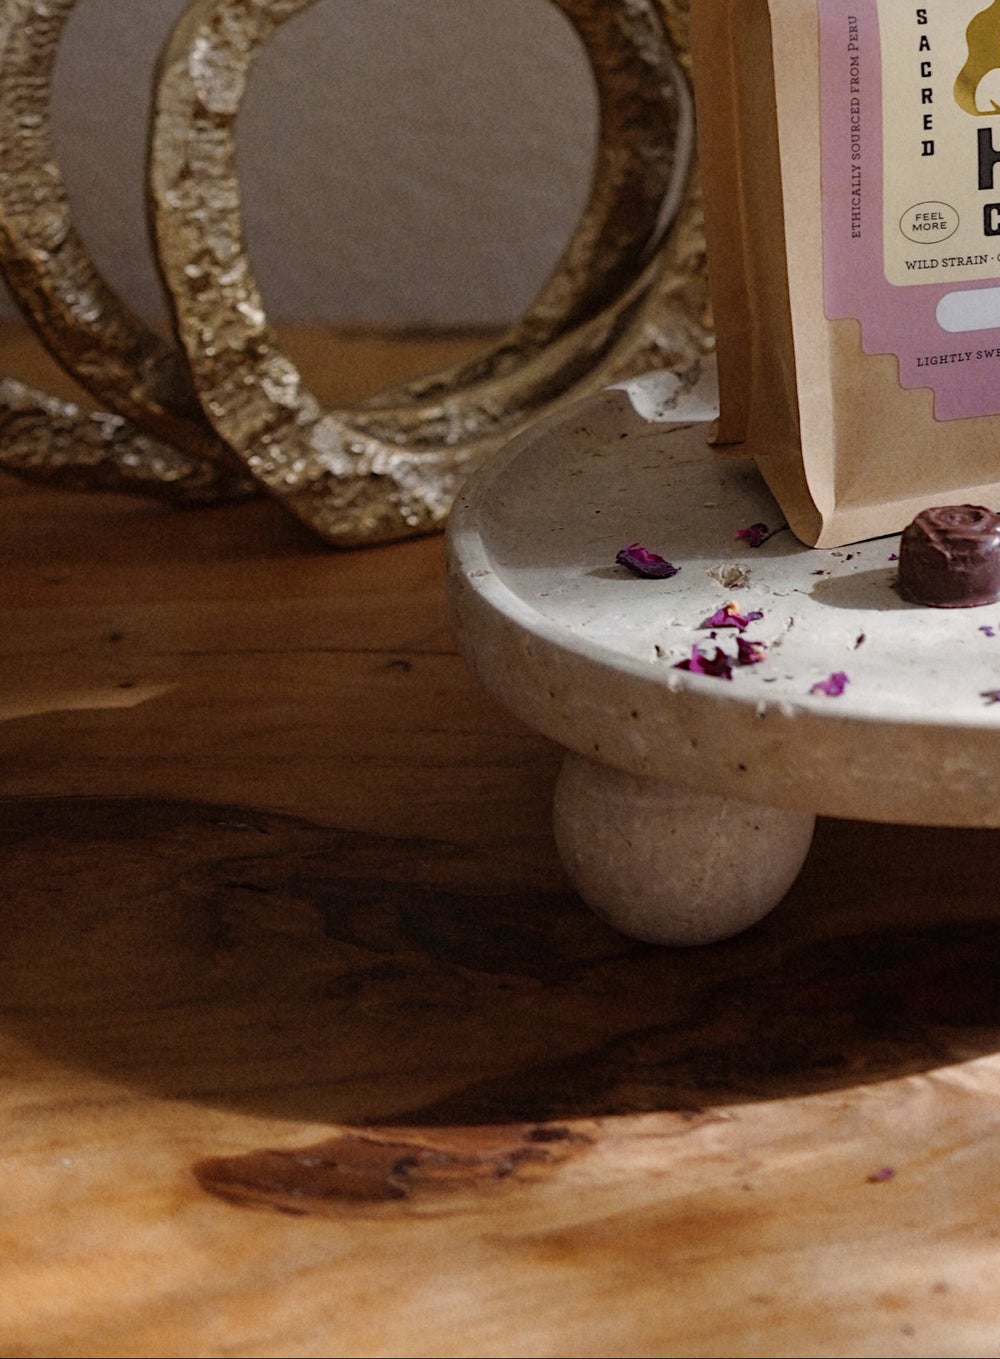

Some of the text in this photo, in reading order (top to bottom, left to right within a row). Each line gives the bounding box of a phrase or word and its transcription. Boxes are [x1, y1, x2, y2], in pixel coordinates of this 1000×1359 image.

[850, 55, 861, 93] FROM
[916, 8, 935, 157] SACRED
[851, 97, 861, 161] SOURCED
[851, 164, 862, 239] ETHICALLY
[911, 221, 947, 232] MORE
[915, 211, 945, 221] FEEL
[905, 258, 939, 271] WILD
[941, 253, 989, 268] STRAIN
[916, 351, 972, 367] LIGHTLY
